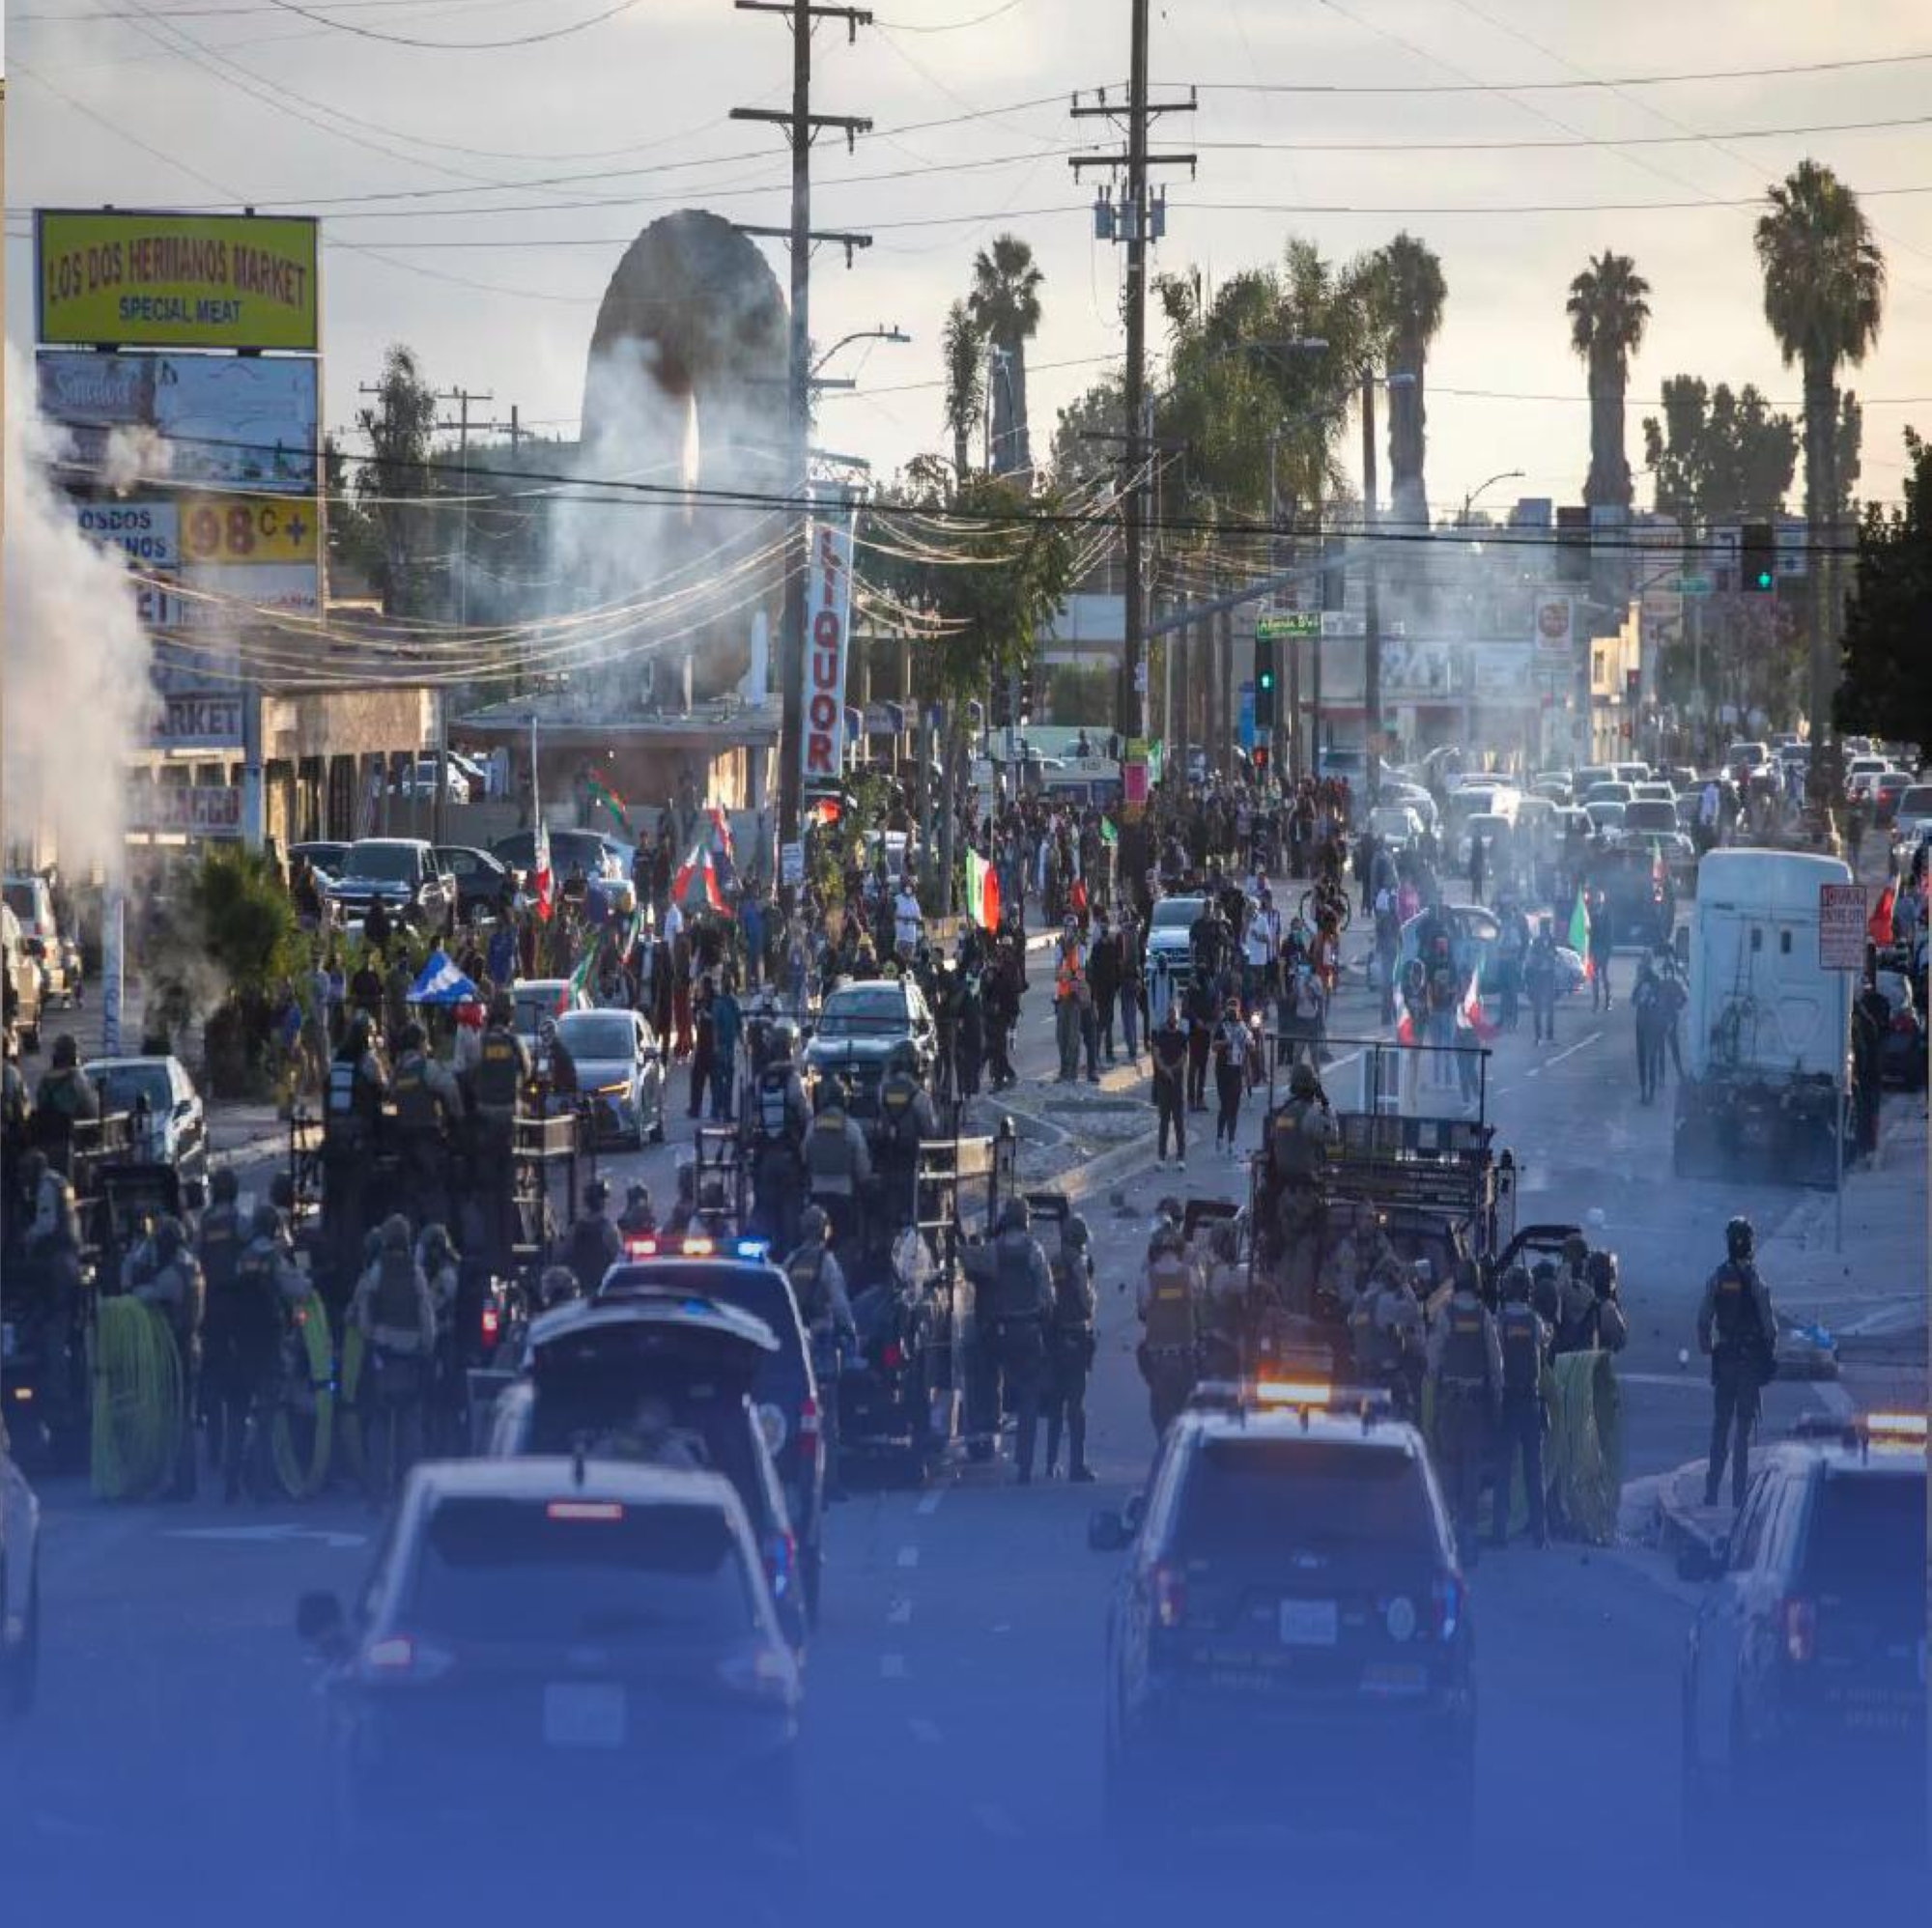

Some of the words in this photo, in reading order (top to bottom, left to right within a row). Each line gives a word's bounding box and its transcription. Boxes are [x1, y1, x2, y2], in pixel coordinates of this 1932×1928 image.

[48, 251, 82, 307] LOS
[88, 241, 122, 291] DOS
[128, 237, 227, 285] HERMANOS
[234, 241, 305, 309] MARKET
[119, 295, 192, 323] SPECIAL
[196, 299, 242, 325] MEAT
[808, 526, 842, 773] LIQUOR
